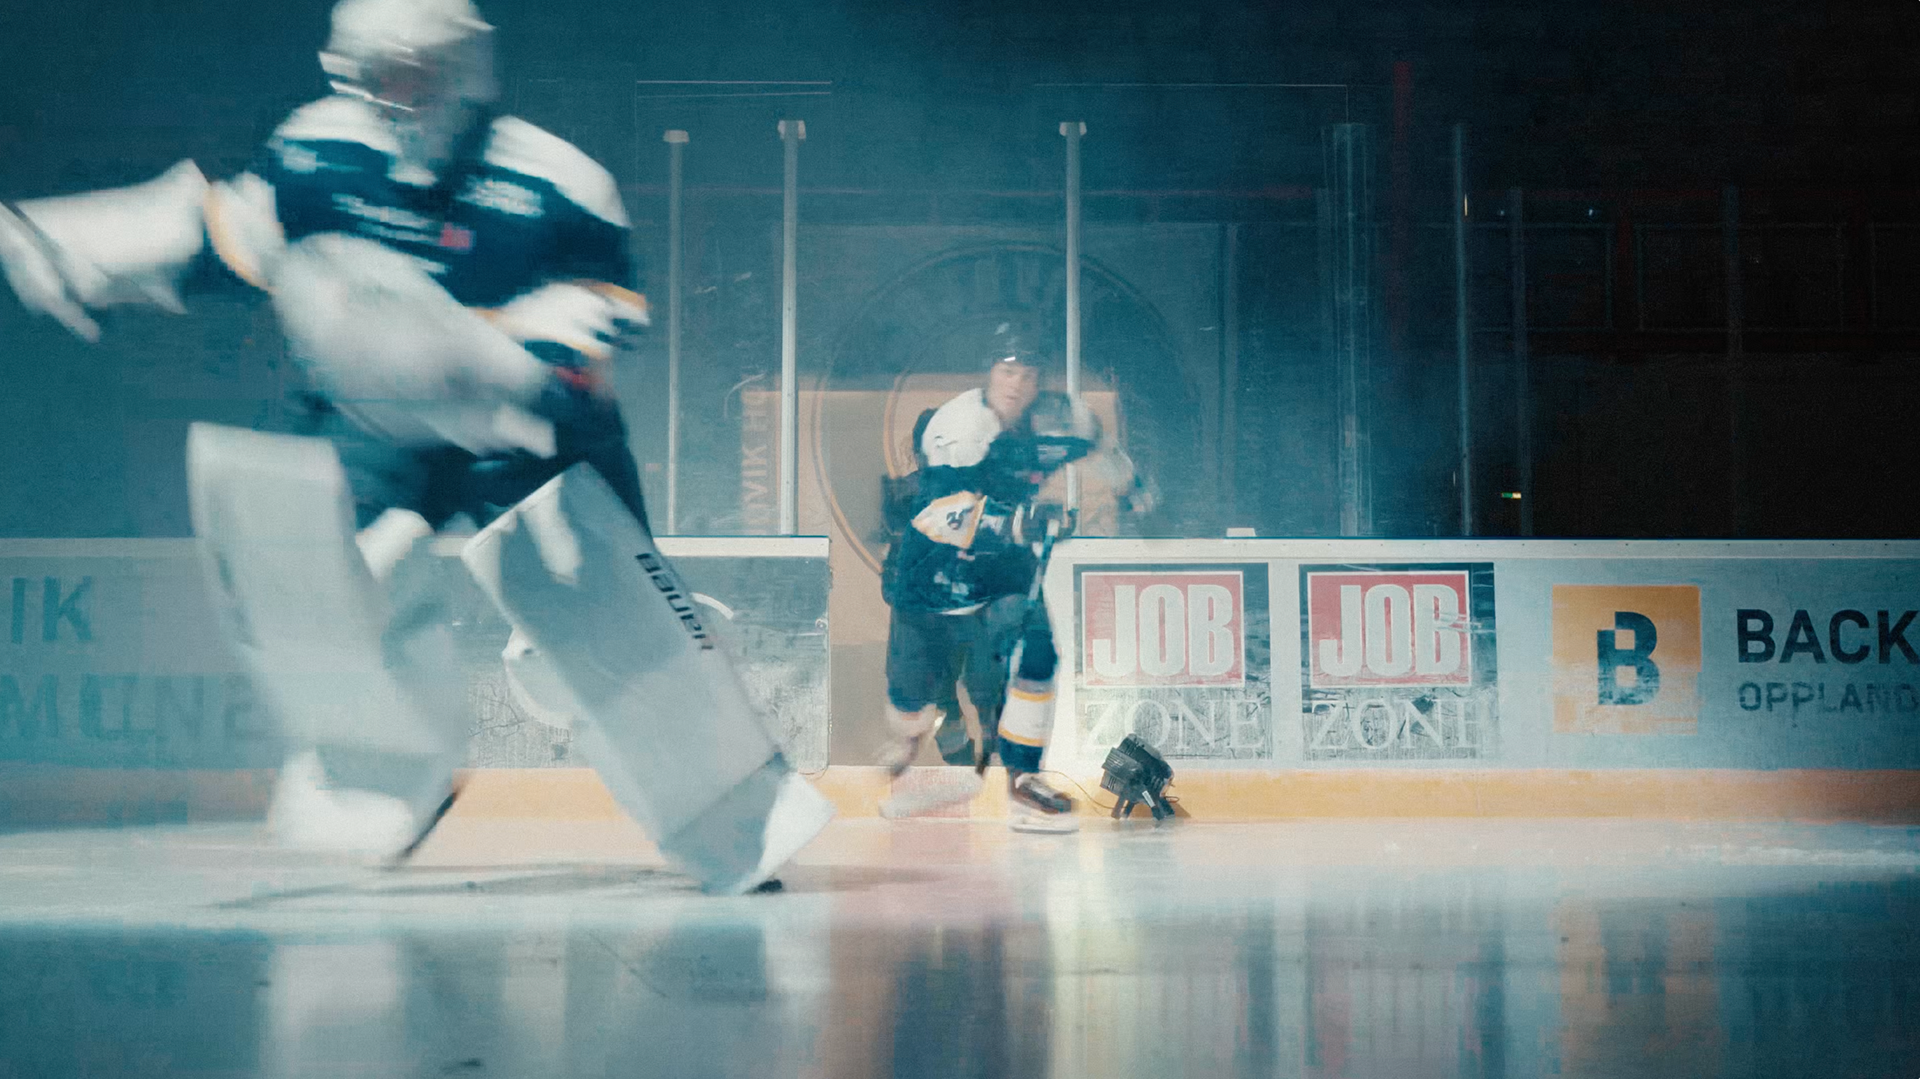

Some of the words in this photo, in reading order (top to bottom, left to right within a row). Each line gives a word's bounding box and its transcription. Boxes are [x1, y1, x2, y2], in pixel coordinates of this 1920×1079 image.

[10, 576, 92, 644] IK
[1092, 584, 1236, 677] JOB
[1319, 584, 1462, 677] JOB
[1736, 608, 1920, 665] BACK
[1597, 611, 1660, 705] B
[1084, 699, 1265, 749] ZONE
